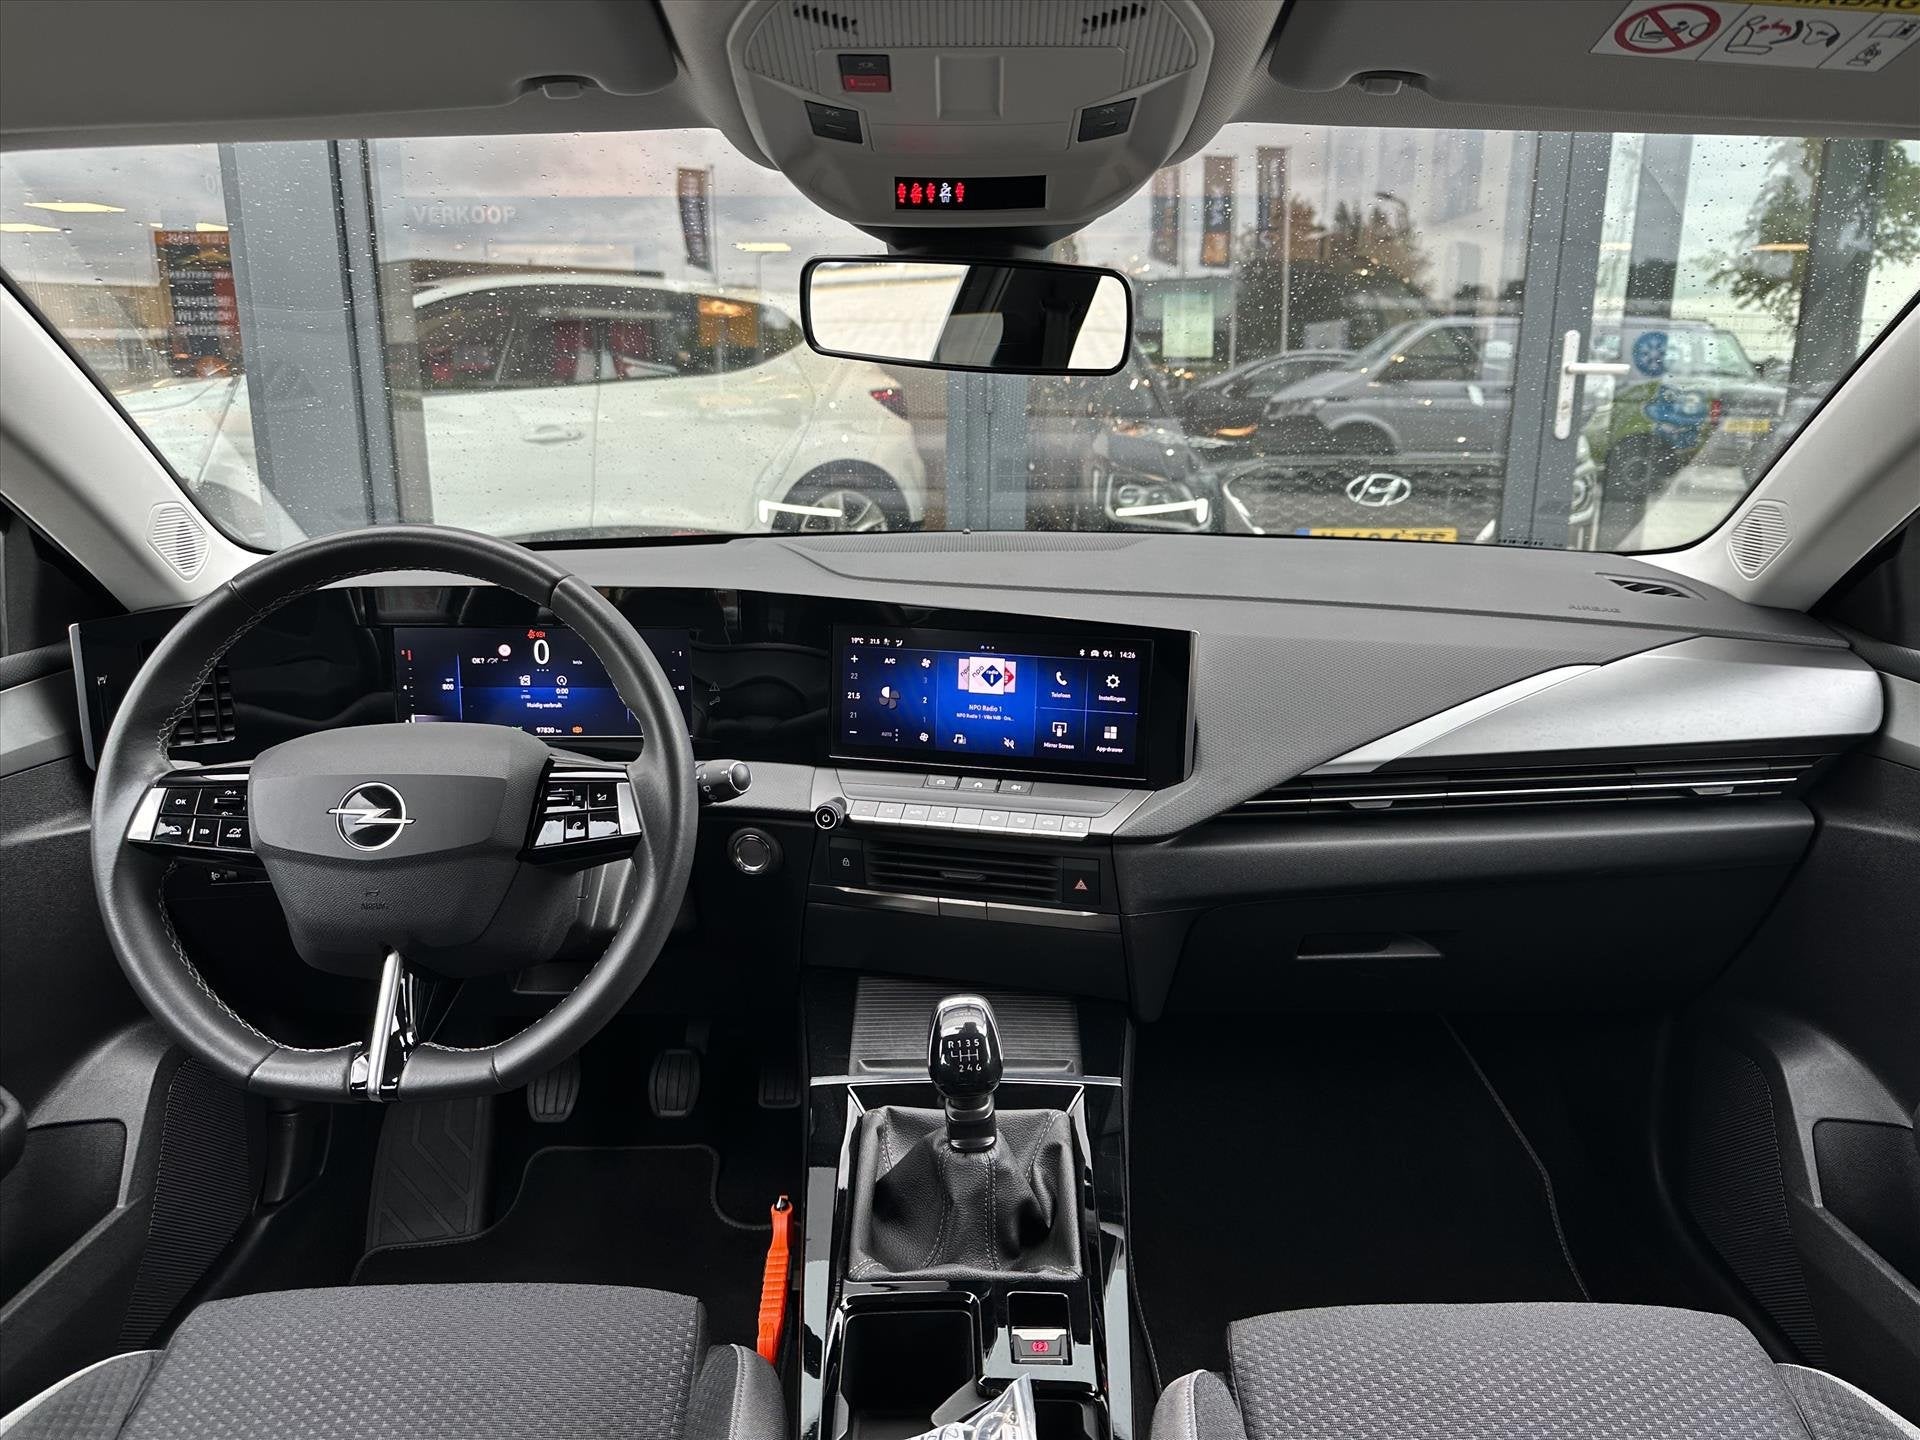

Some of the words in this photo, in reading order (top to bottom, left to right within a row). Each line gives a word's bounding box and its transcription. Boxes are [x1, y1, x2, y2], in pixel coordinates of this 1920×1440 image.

[413, 206, 516, 224] VERKOOP
[533, 639, 550, 665] 0
[1119, 651, 1136, 659] 14:26
[850, 672, 859, 680] 22
[847, 692, 861, 700] 21.5
[849, 711, 857, 719] 21
[175, 798, 187, 806] OK
